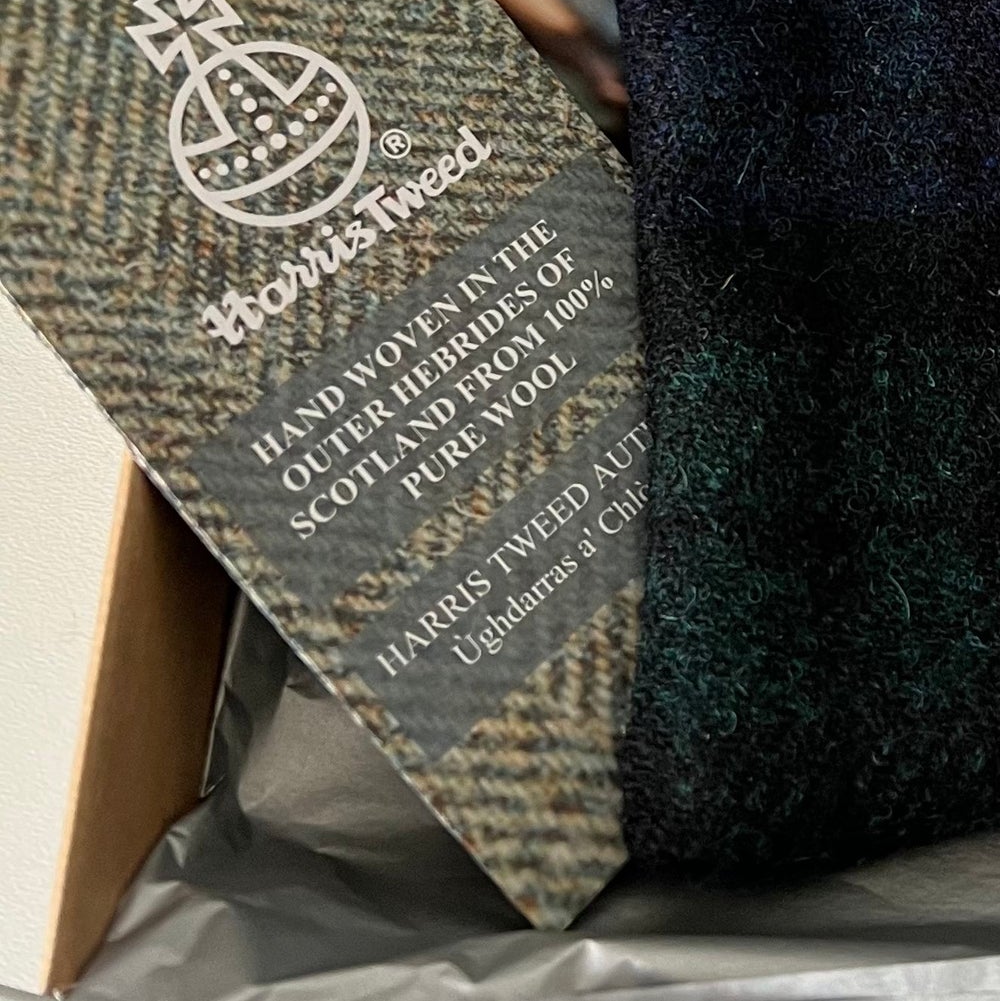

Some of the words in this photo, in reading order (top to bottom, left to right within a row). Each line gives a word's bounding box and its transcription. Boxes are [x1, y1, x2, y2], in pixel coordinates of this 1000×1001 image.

[250, 383, 346, 466] HAND
[342, 293, 463, 390] WOVEN
[456, 264, 499, 304] IN
[491, 218, 559, 274] THE
[281, 398, 396, 492] OUTER
[388, 280, 538, 407] HEBRIDES
[535, 247, 580, 289] OF
[289, 396, 457, 540] SCOTLAND
[454, 322, 547, 405] FROM
[543, 269, 614, 332] 100%
[399, 421, 488, 501] PURE
[479, 350, 579, 430] WOOL
[375, 569, 492, 677] HARRIS
[486, 482, 591, 576] TWEED
[592, 422, 648, 490] AUT
[452, 554, 579, 666] Ùghdarras
